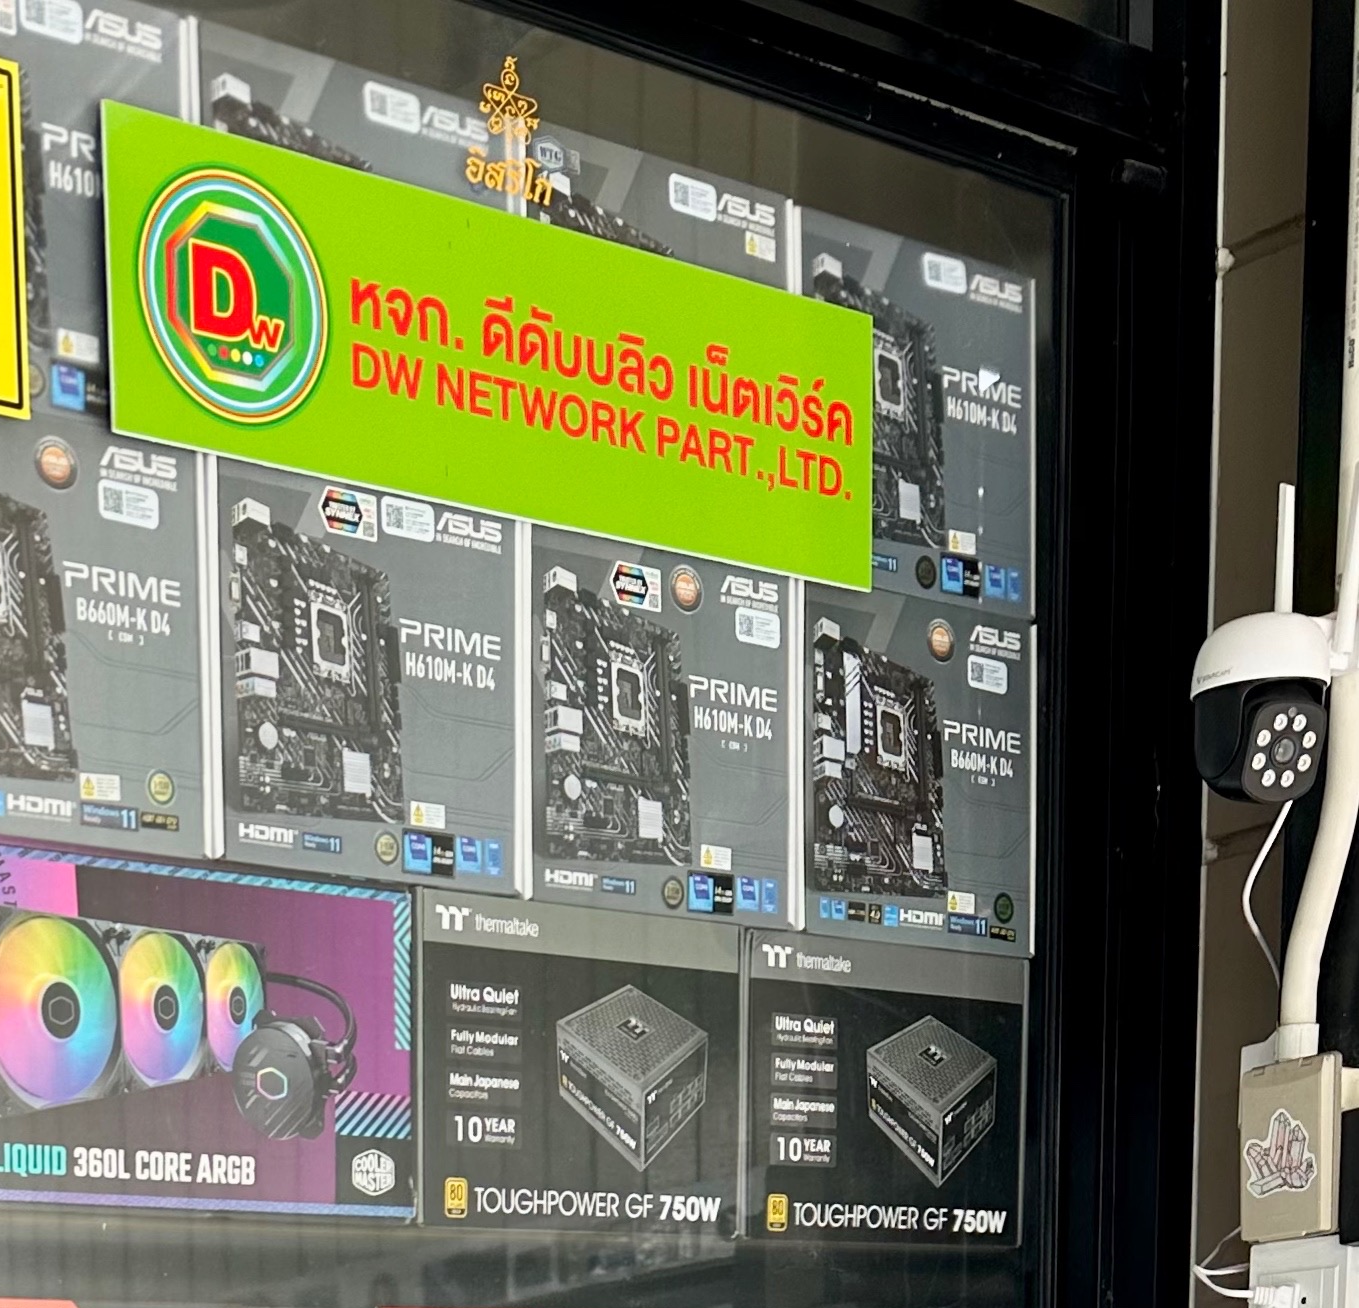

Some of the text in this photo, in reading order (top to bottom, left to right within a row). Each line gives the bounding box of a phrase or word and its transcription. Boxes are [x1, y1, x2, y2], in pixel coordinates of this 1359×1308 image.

[718, 193, 775, 225] ASUS
[970, 274, 1022, 303] ASUS
[349, 276, 855, 447] หจก. ดีดับบลิว เน็ตเวิร์ค
[350, 343, 422, 402] DW
[435, 365, 646, 453] NETWORK
[100, 447, 177, 480] ASUS
[436, 511, 502, 543] ASUS
[63, 561, 181, 607] PRIME
[720, 575, 778, 602] ASUS
[77, 598, 171, 637] B660M-K D4
[399, 618, 501, 661] PRIME
[970, 625, 1021, 651] ASUS
[405, 652, 496, 692] H610M-K D4
[688, 674, 778, 712] PRIME
[694, 706, 772, 740] H610M-K D4
[943, 719, 1021, 755] PRIME
[951, 748, 1014, 779] B660M-K D4
[7, 794, 73, 817] HDMI
[121, 806, 137, 828] 11
[474, 912, 539, 937] thermaltake
[899, 908, 945, 926] HDMI
[796, 952, 851, 973] thermaltake
[450, 983, 520, 1005] Ultra Quiet
[450, 1029, 518, 1046] Fully Modular
[775, 1016, 834, 1035] Ultra Quiet
[775, 1058, 834, 1074] Fully Modular
[449, 1073, 520, 1090] Main Japanese
[773, 1098, 835, 1114] Main Japanese
[454, 1116, 515, 1143] 10 YEAR
[777, 1137, 831, 1162] 10 YEAR
[73, 1145, 130, 1181] 360L
[135, 1150, 192, 1184] CORE
[196, 1152, 256, 1187] ARGB
[449, 1182, 463, 1201] 80
[474, 1186, 721, 1222] TOUGHPOWER GF 750W
[793, 1202, 1007, 1234] TOUGHPOWER GF 750W
